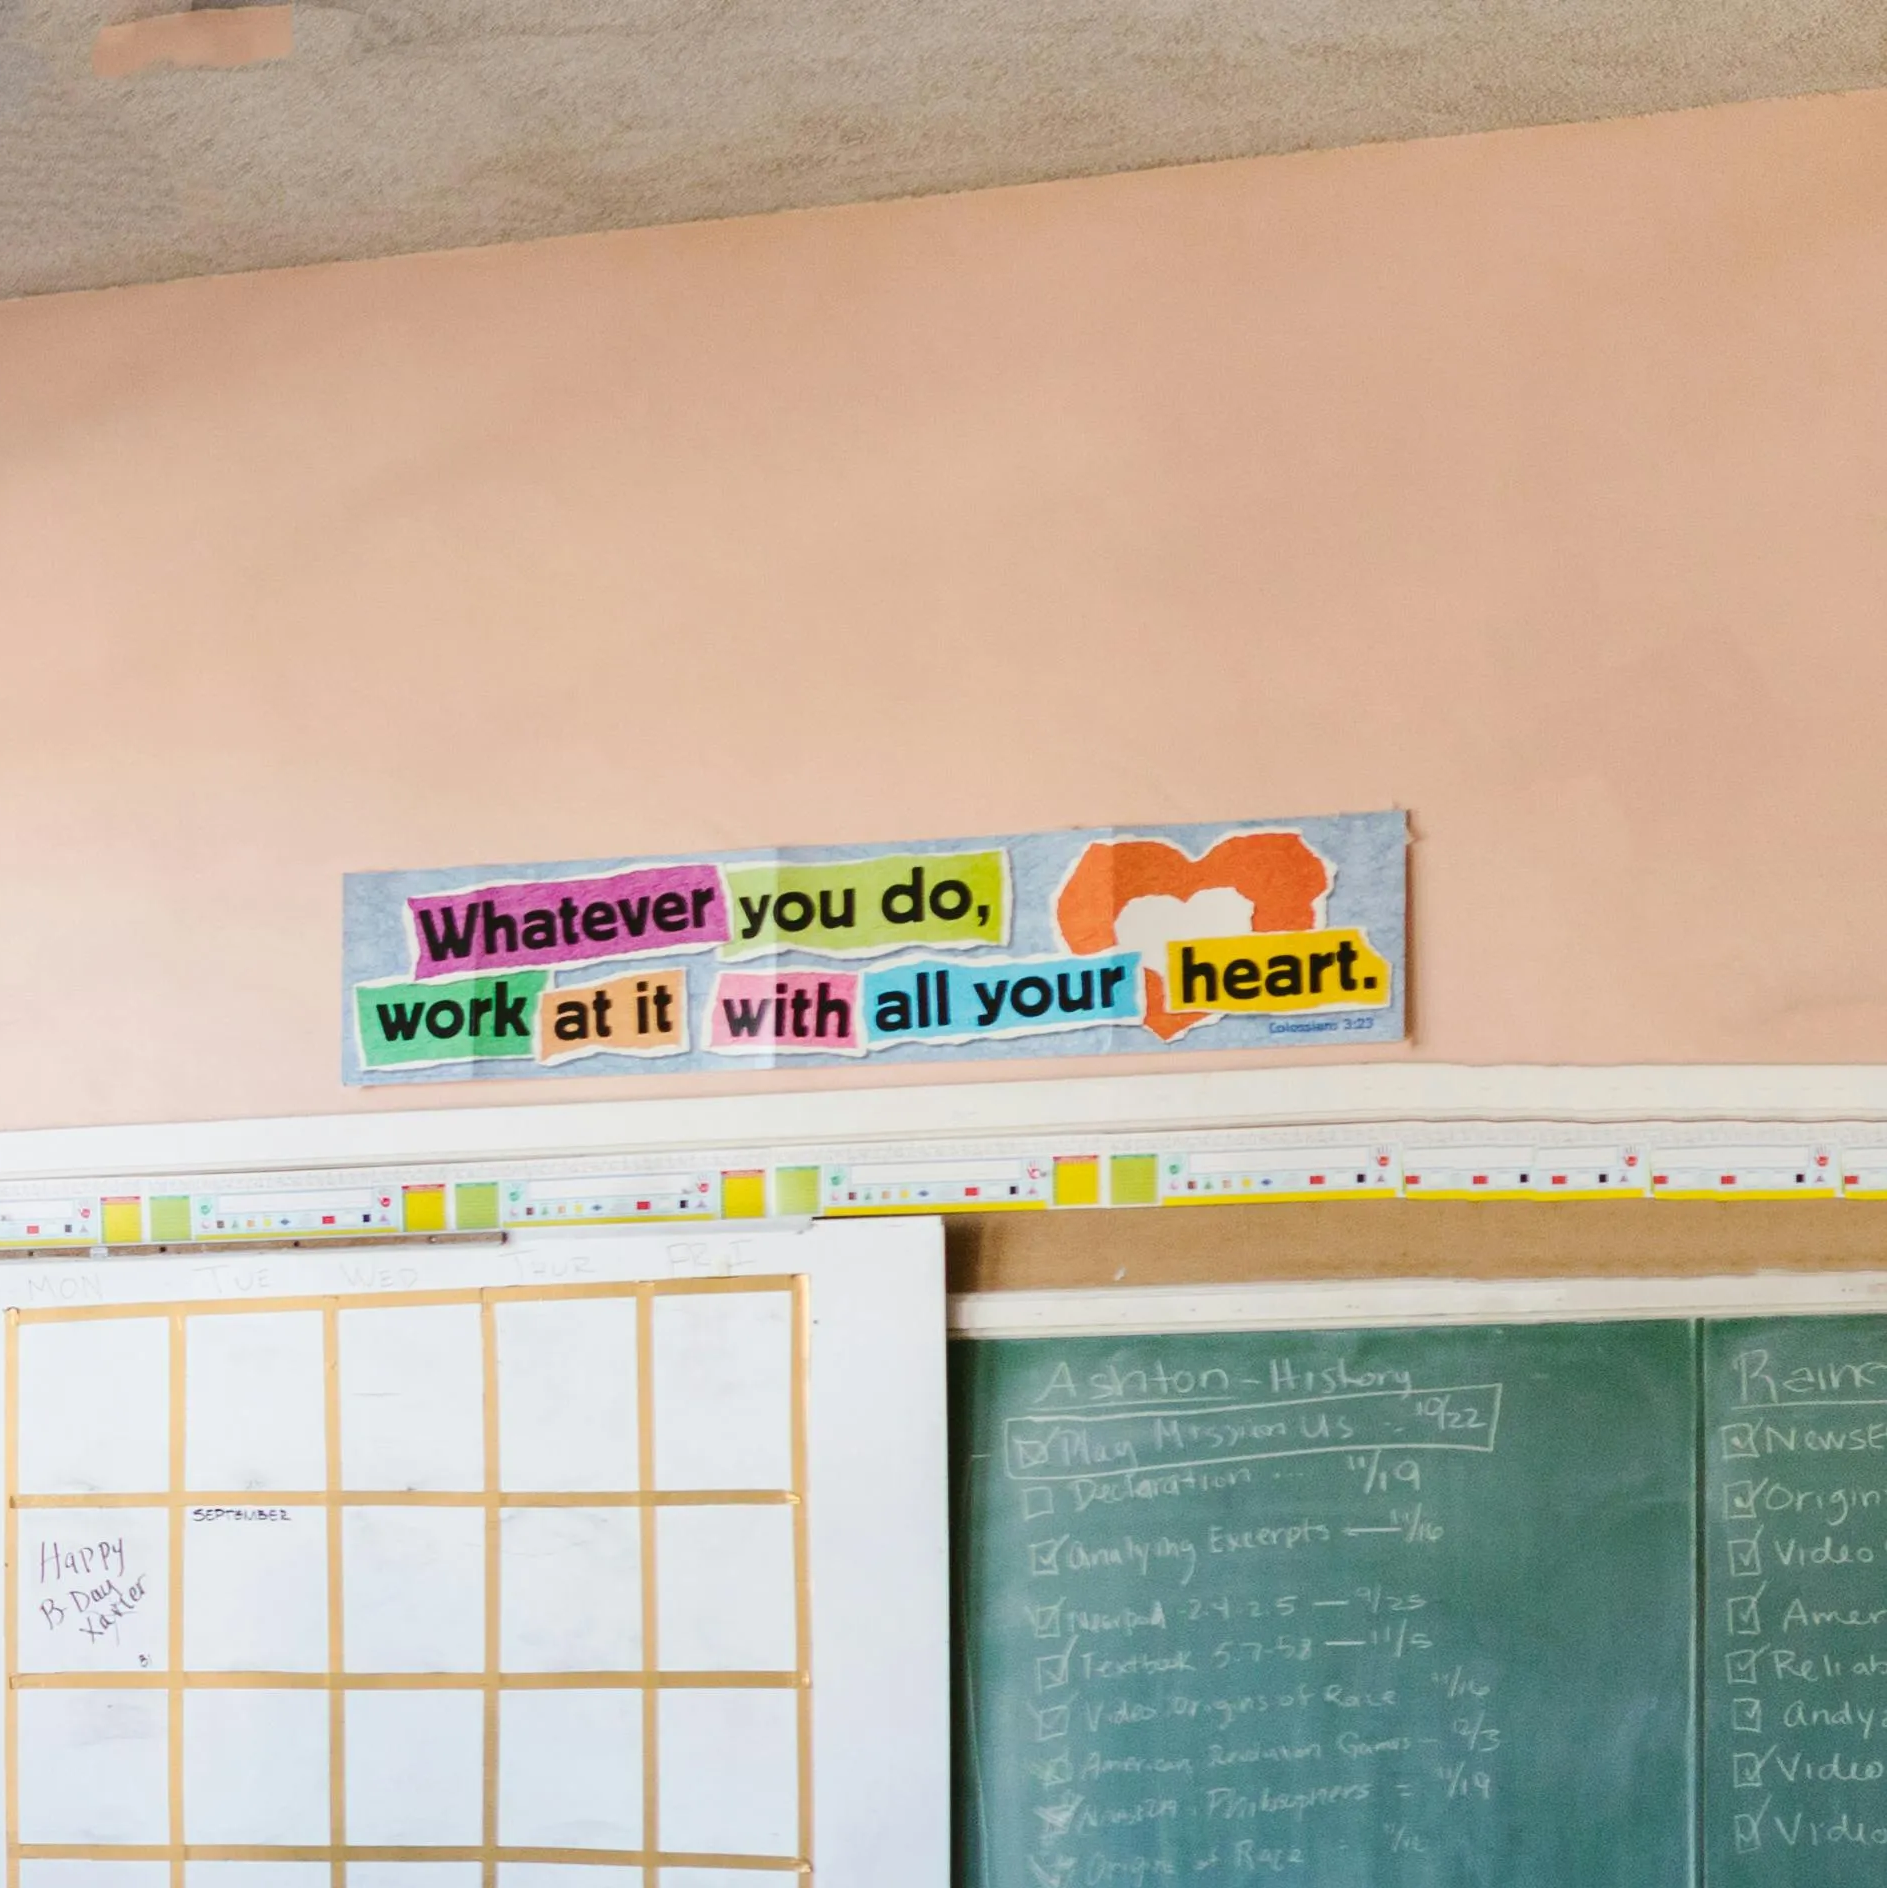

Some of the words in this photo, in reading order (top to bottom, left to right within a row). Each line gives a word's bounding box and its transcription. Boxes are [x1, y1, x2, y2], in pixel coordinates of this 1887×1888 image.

[418, 881, 715, 961] Whatever
[737, 885, 857, 939] you
[881, 864, 991, 931] do,
[376, 977, 532, 1042] work
[554, 991, 615, 1040] at
[634, 981, 672, 1032] it
[721, 982, 851, 1039] with
[873, 973, 953, 1030] all
[973, 956, 1125, 1026] your
[1180, 938, 1378, 1003] heart.
[1034, 1360, 1229, 1402] Ashton
[1270, 1358, 1412, 1399] History
[1415, 1395, 1486, 1431] 10/22
[1765, 1423, 1887, 1454] NewsE
[1070, 1467, 1251, 1512] Declaration
[1347, 1447, 1421, 1494] 11/19
[192, 1508, 291, 1522] SEPTEMBER
[1765, 1483, 1887, 1526] Origin
[1208, 1517, 1330, 1553] Excerpts
[1774, 1537, 1874, 1568] Video
[40, 1537, 124, 1583] Happy
[1782, 1599, 1887, 1633] Amer
[1771, 1650, 1887, 1682] Reliab
